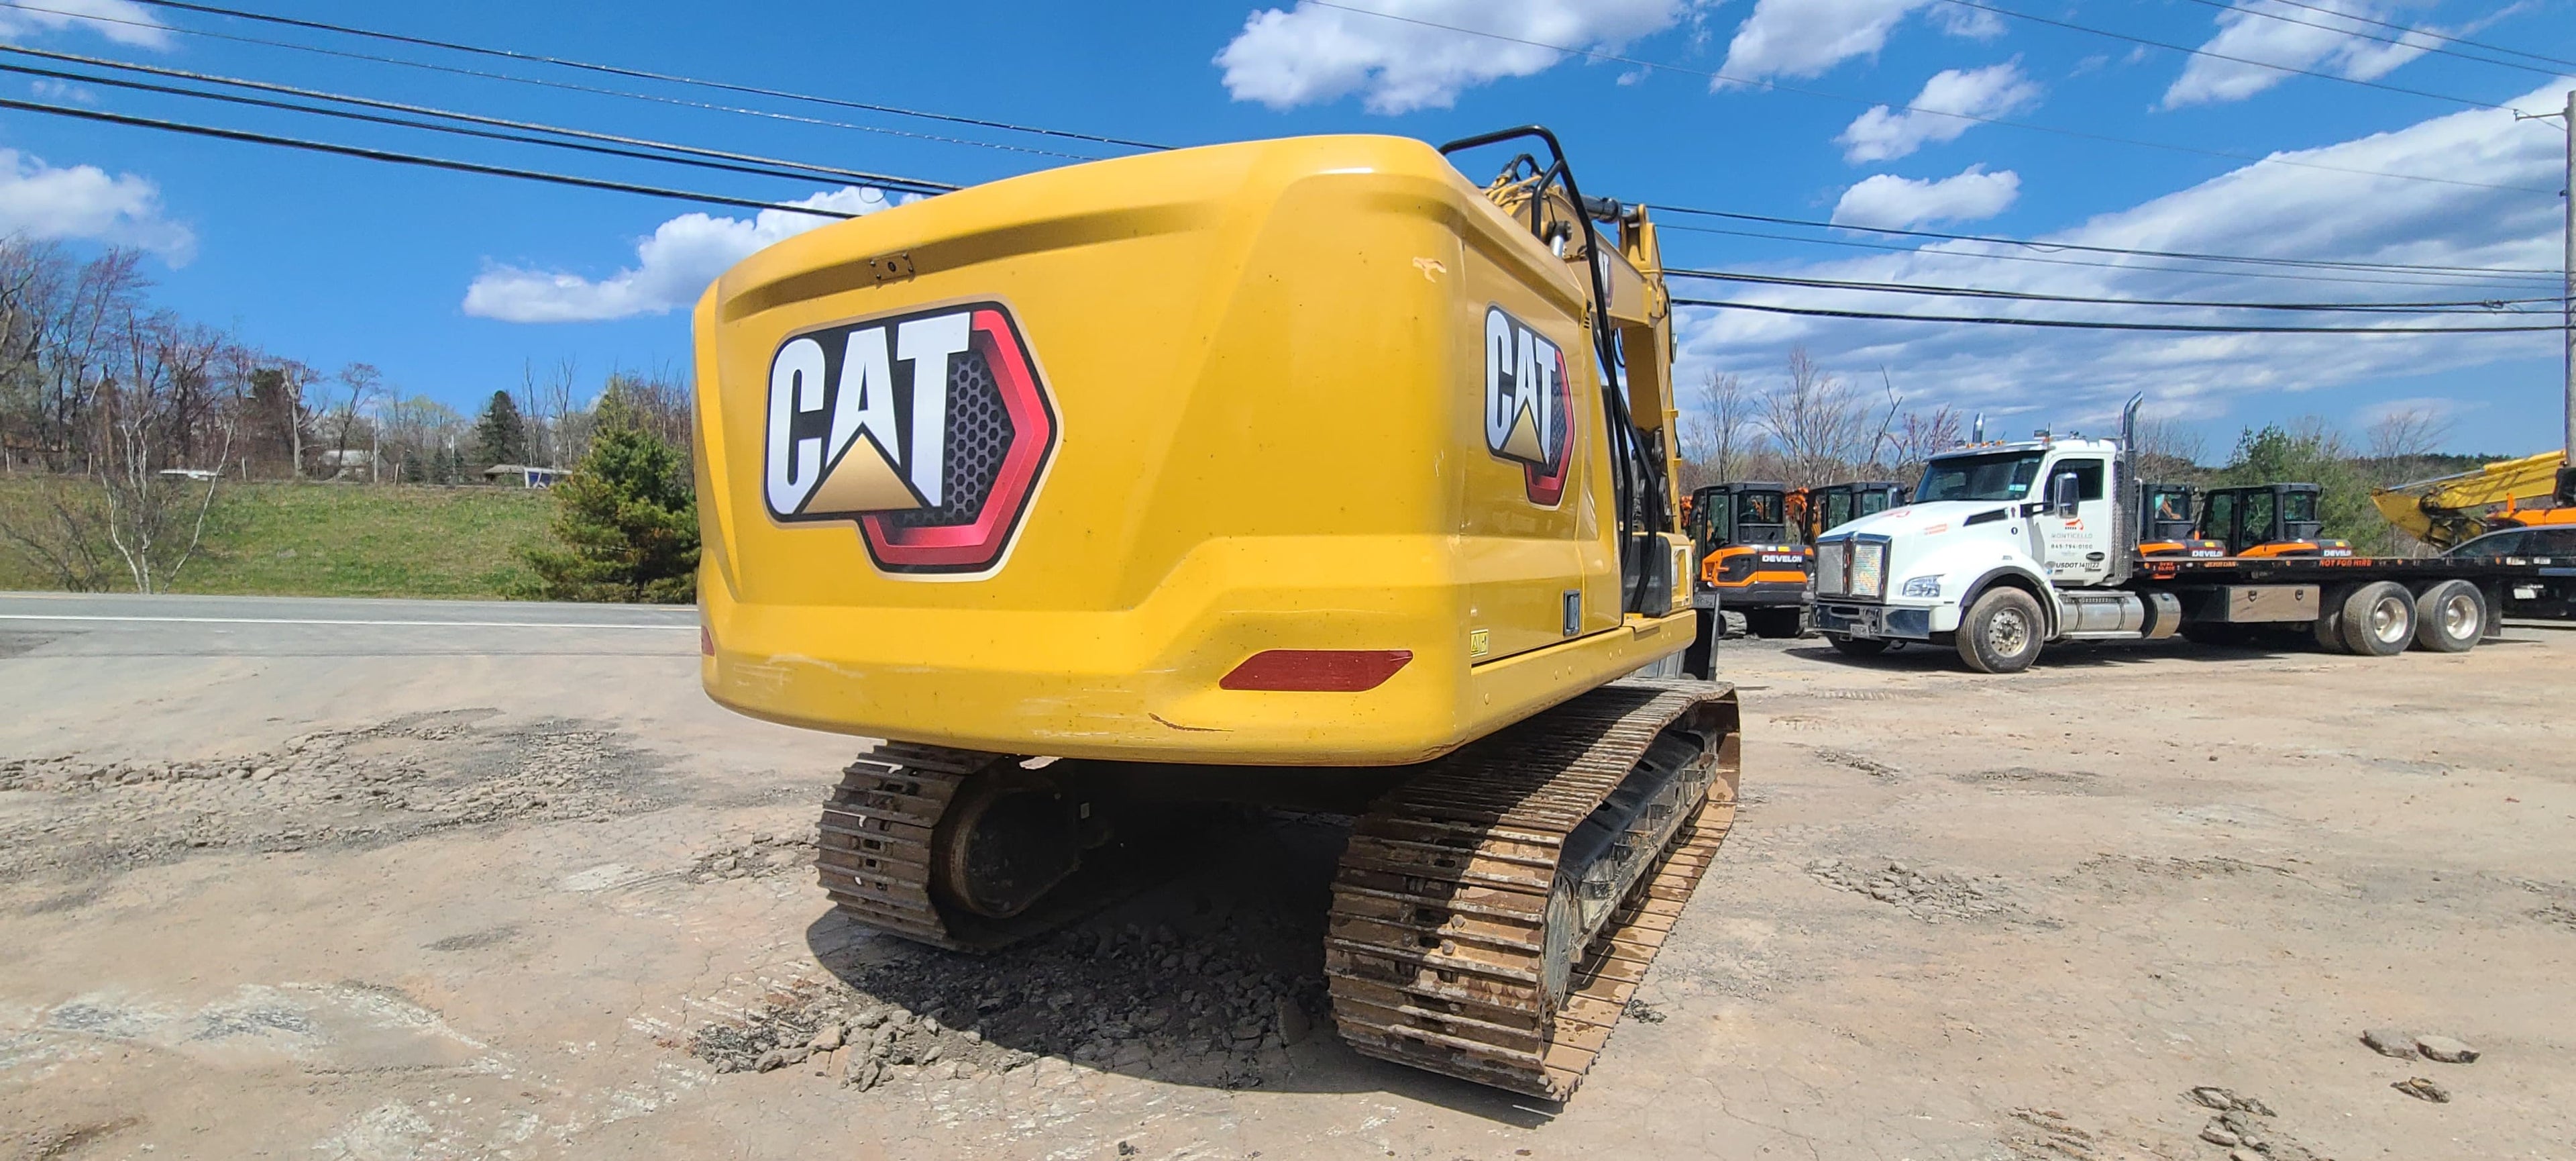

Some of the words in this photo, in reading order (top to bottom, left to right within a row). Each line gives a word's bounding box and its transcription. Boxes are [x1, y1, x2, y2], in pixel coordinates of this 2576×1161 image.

[767, 311, 971, 515] CAT
[1487, 310, 1556, 466] CAT
[1762, 554, 1803, 562] DEVELON
